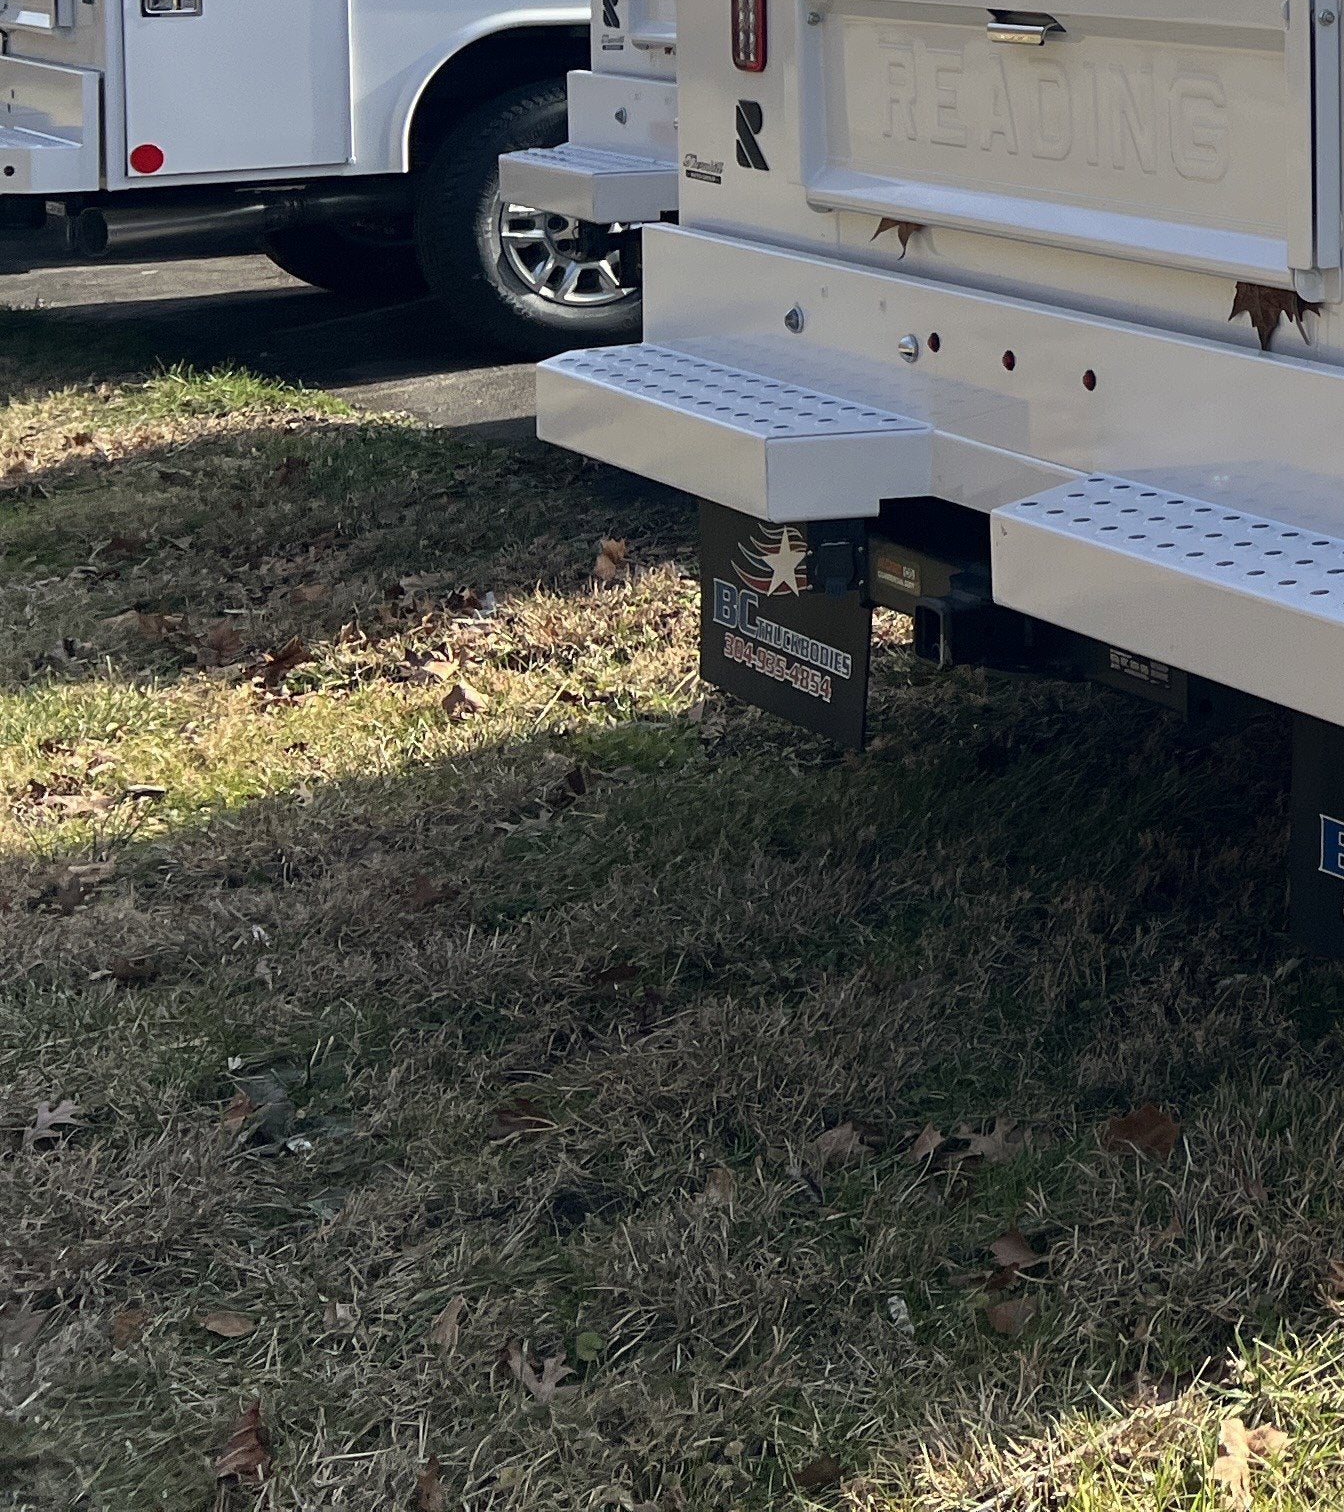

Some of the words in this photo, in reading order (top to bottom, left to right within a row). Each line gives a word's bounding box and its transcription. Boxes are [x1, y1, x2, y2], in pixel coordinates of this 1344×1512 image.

[877, 34, 1231, 184] READING
[713, 577, 759, 640] BC
[723, 630, 832, 704] 304-935-4854
